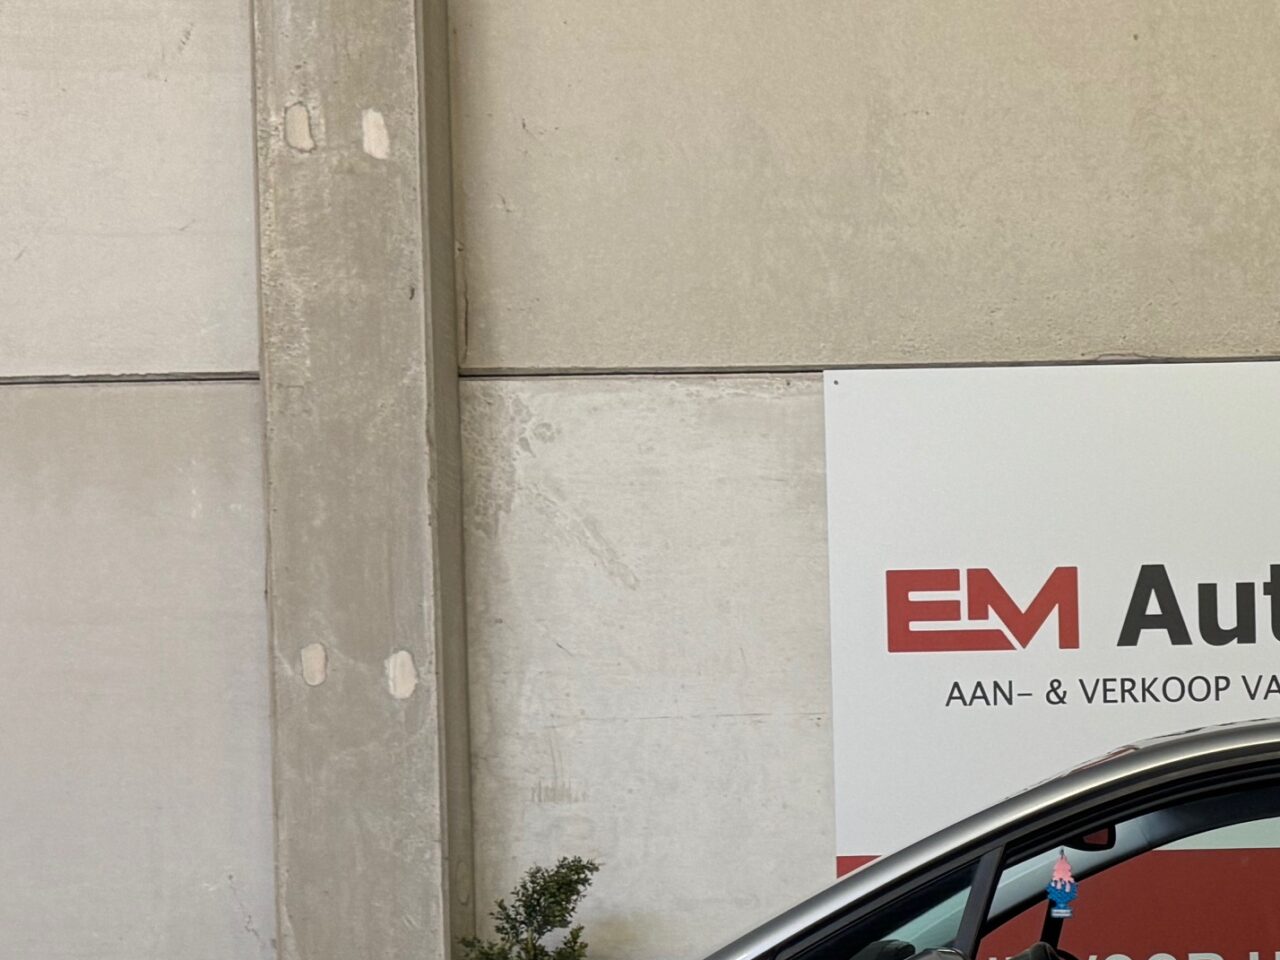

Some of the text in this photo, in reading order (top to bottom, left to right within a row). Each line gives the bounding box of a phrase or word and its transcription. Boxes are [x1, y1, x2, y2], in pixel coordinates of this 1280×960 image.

[885, 566, 1080, 653] EM
[1045, 678, 1068, 706] &
[1078, 675, 1231, 704] VERKOOP
